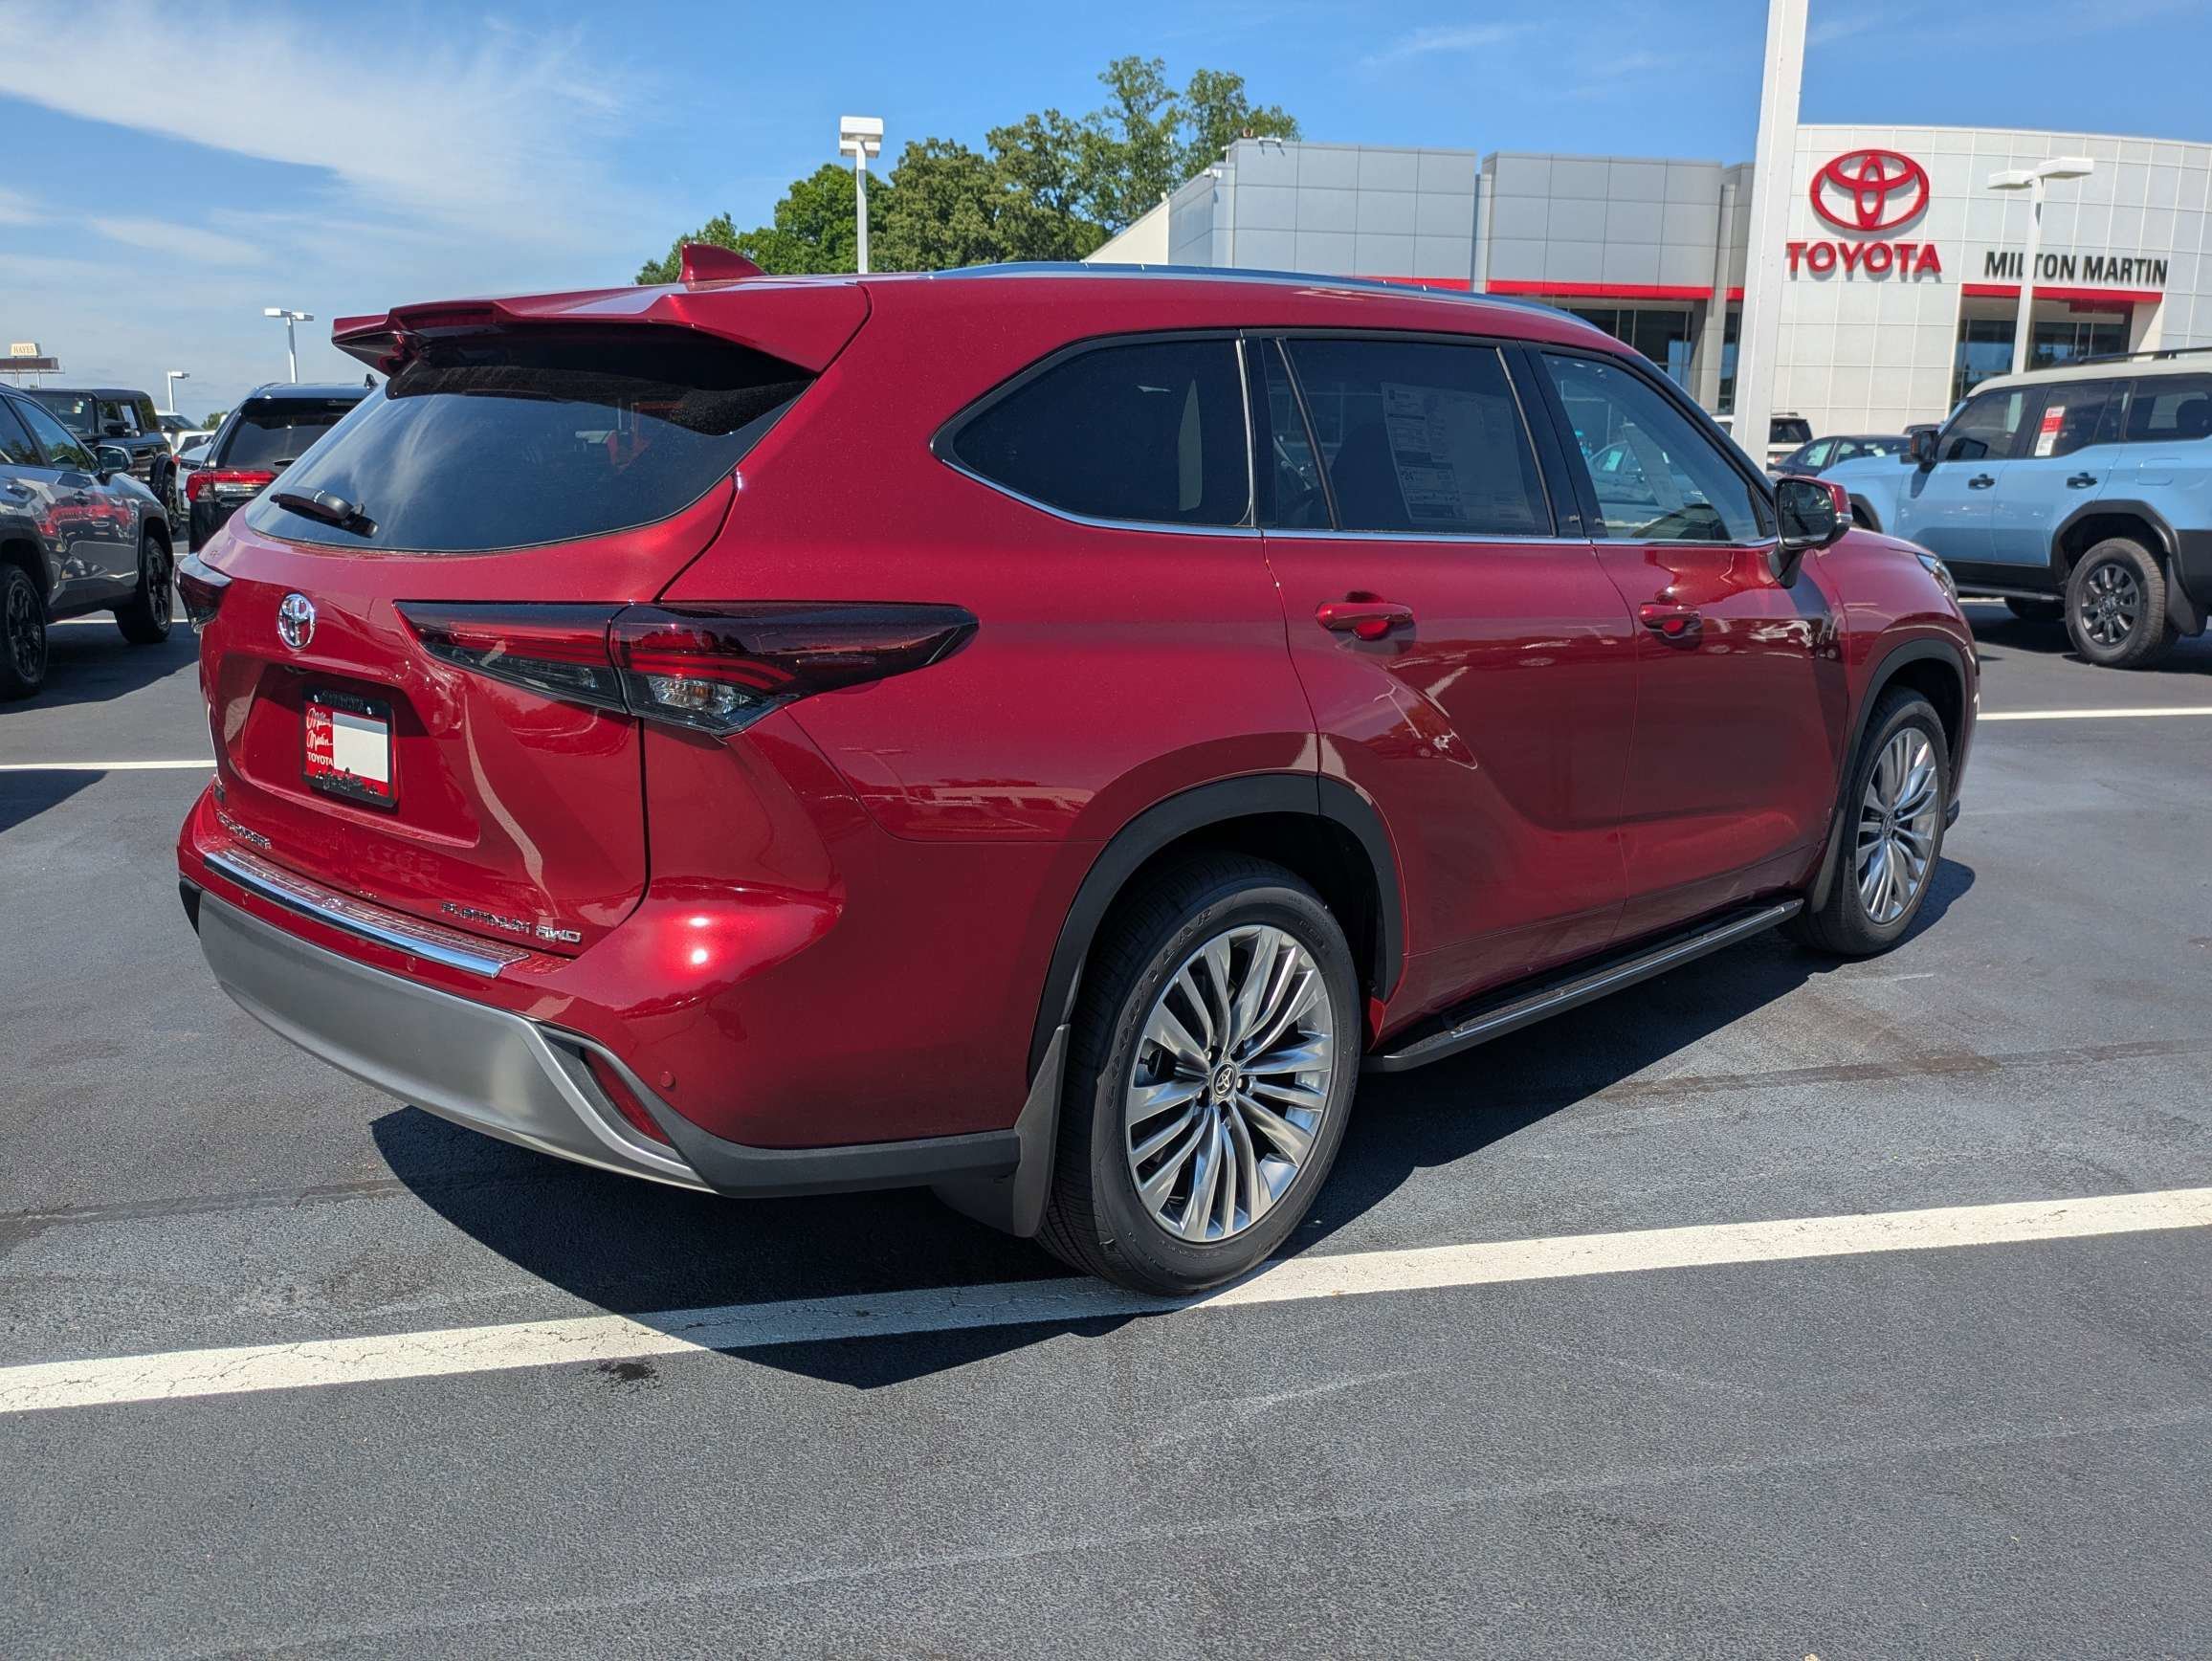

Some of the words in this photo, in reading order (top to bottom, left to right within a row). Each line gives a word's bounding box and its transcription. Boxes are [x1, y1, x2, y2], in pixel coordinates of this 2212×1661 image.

[1786, 241, 1941, 274] TOYOTA
[1983, 251, 2076, 281] MILTON
[2081, 255, 2168, 285] MARTIN
[306, 751, 333, 766] TOYOTA
[441, 902, 530, 934] PLATINUM
[535, 924, 582, 943] AWD
